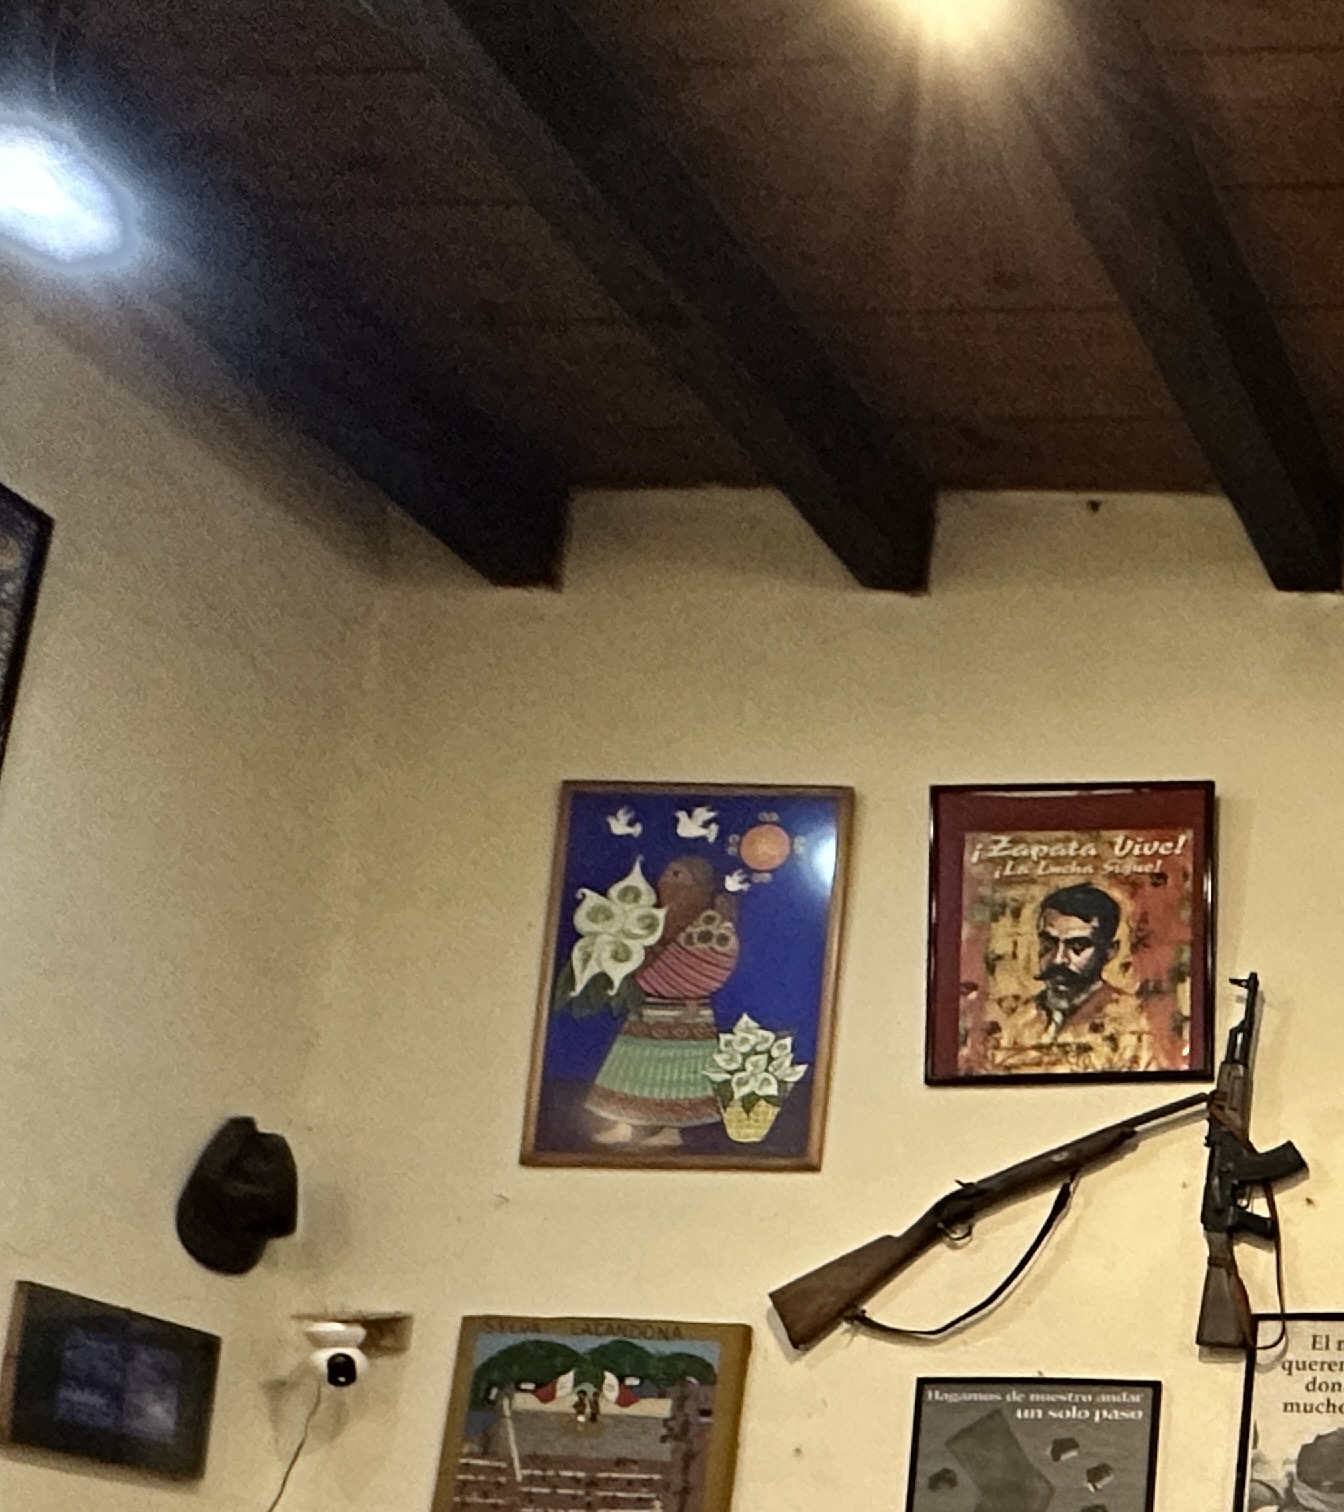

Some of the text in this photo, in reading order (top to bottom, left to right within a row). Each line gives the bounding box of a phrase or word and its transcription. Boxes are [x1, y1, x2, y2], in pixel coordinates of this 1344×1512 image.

[1113, 834, 1188, 857] Vive!
[1311, 1334, 1330, 1350] El
[927, 1390, 1002, 1403] Hagamos
[1005, 1390, 1024, 1402] de
[1029, 1391, 1092, 1402] nuestro
[1016, 1406, 1144, 1423] un solo paso
